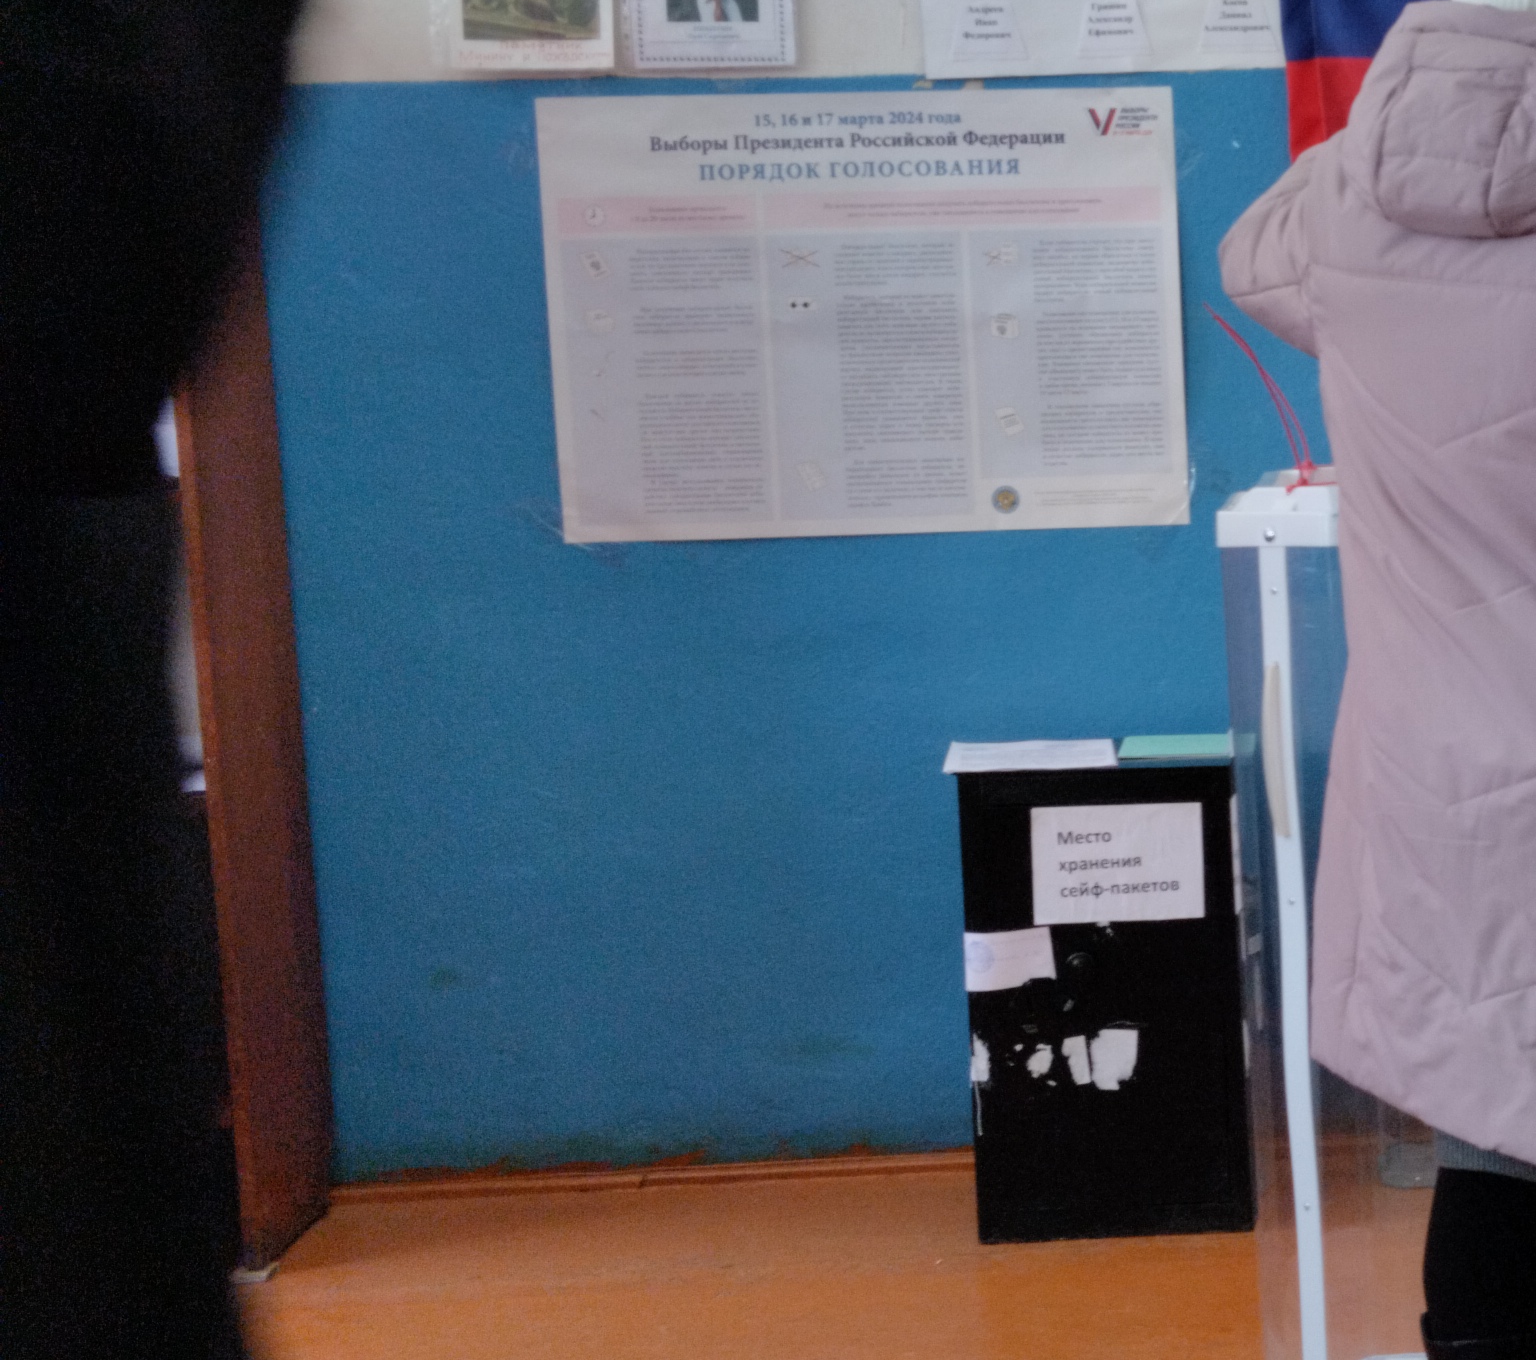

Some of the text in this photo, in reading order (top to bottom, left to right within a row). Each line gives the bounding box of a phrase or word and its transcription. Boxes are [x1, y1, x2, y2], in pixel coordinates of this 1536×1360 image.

[754, 114, 776, 128] 15,
[781, 113, 798, 127] 16
[817, 112, 834, 126] 17
[838, 114, 884, 128] марта
[889, 111, 924, 125] 2024
[928, 113, 962, 125] года
[650, 130, 1066, 155] Выборы Президента Российской Федерации
[699, 159, 1021, 182] ПОРЯДОК ГОЛОСОВАНИЯ
[1057, 830, 1112, 846] Место
[1059, 856, 1142, 874] хранения
[1060, 880, 1180, 899] сейф-пакетов
